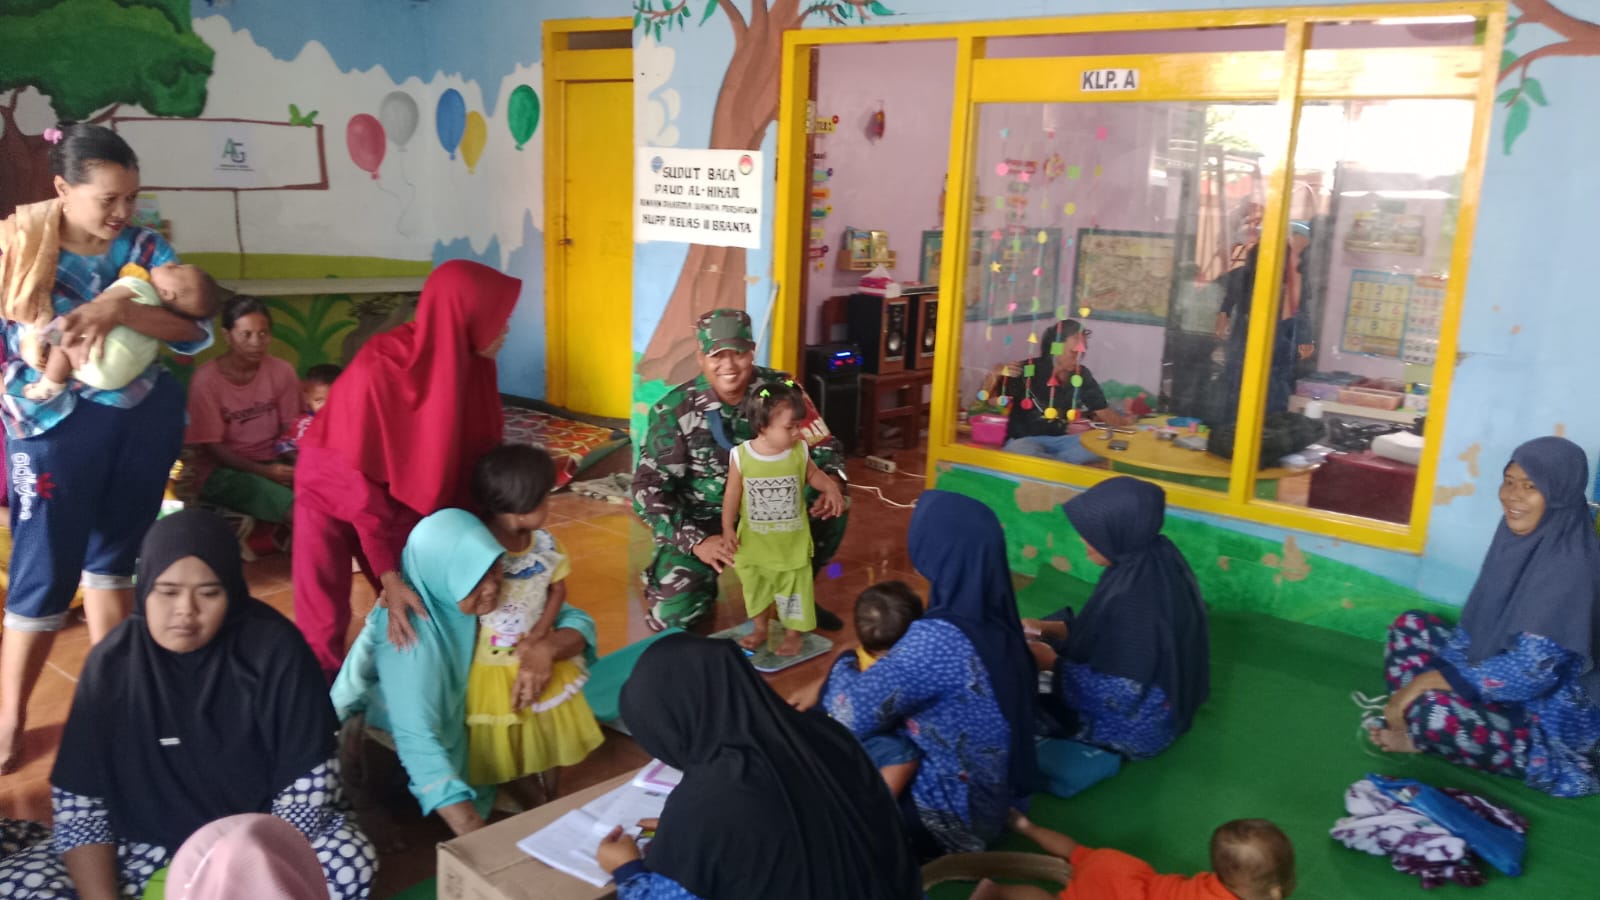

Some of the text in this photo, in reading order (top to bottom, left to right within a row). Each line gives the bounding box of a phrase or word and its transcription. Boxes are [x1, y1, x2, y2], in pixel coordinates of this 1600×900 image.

[1082, 70, 1135, 89] KLP. A
[662, 167, 736, 181] SUDUT BACA
[654, 184, 683, 195] PAUD
[669, 217, 701, 229] KELAS
[712, 220, 752, 233] BRANTA
